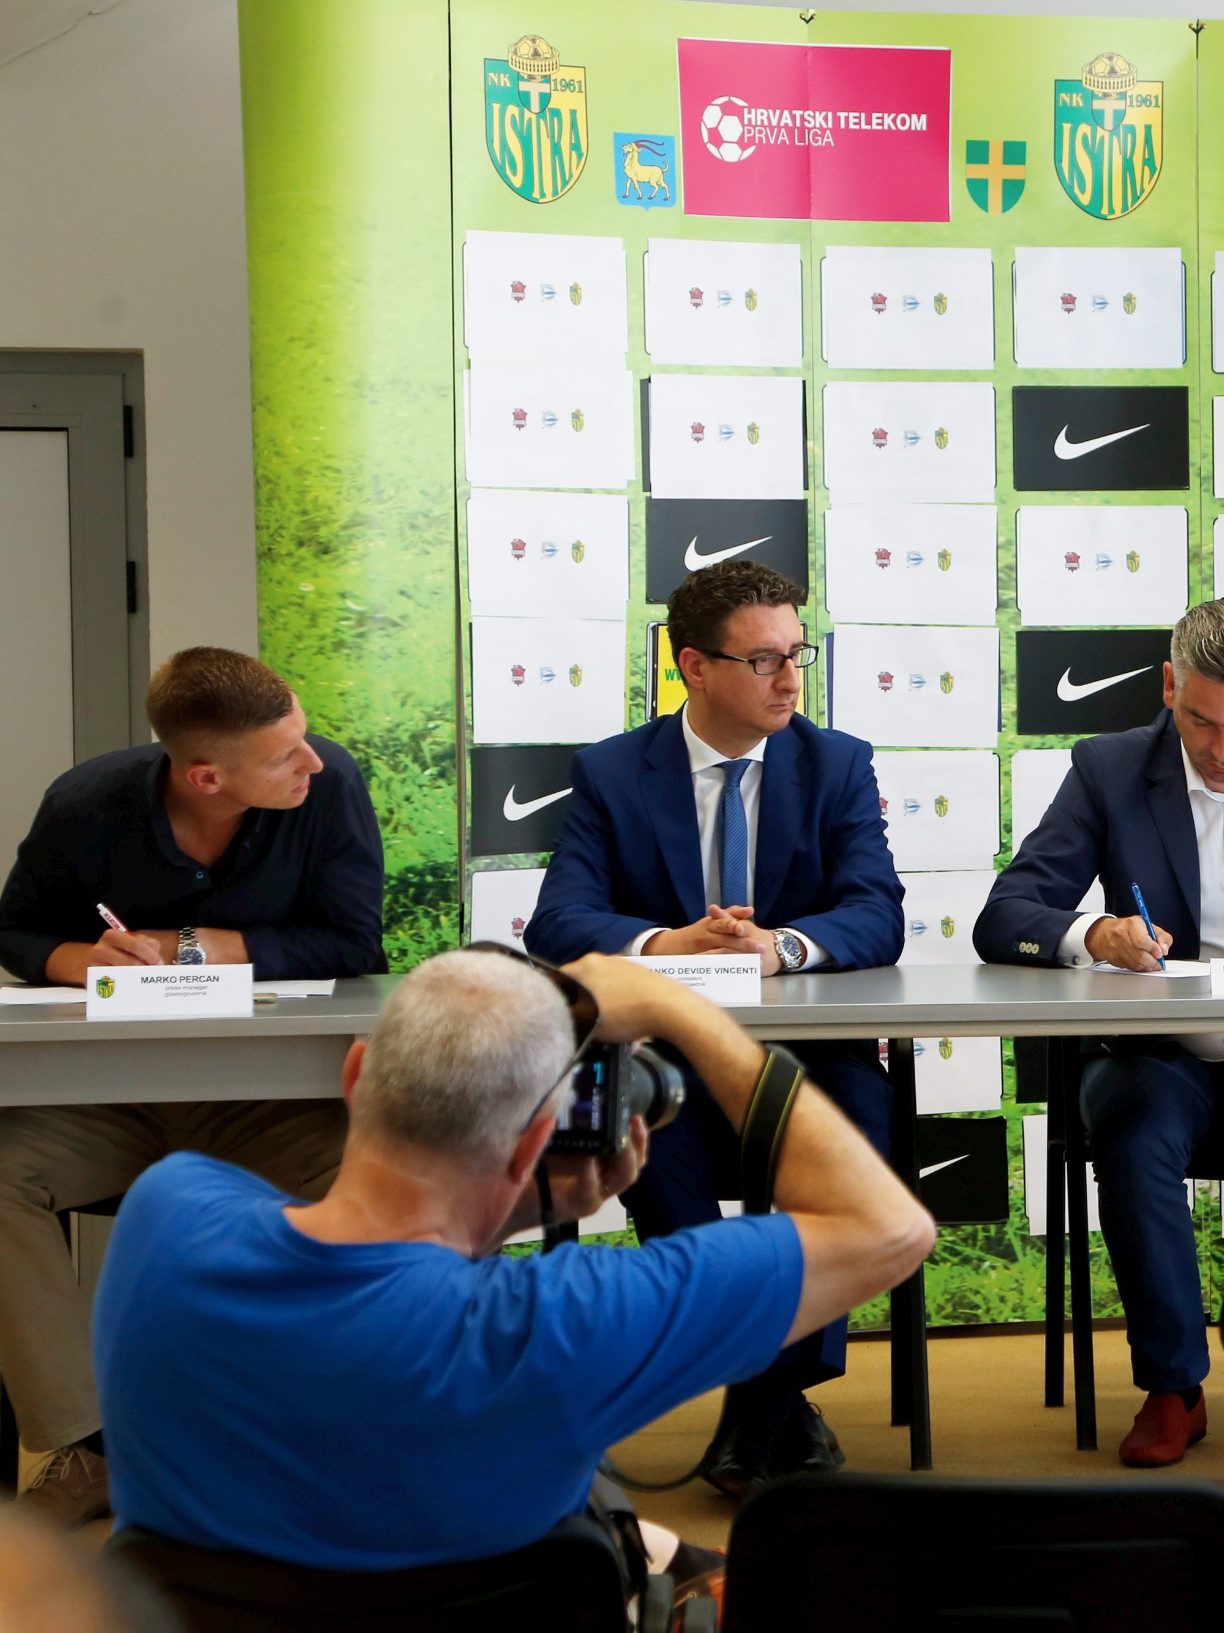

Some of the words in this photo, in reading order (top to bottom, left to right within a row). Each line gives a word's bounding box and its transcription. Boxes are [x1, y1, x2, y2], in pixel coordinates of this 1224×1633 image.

[488, 72, 511, 88] NK
[552, 78, 584, 94] 1961
[1059, 93, 1084, 107] NK
[1127, 94, 1160, 108] 1961
[743, 108, 833, 128] HRVATSKI
[836, 112, 927, 131] TELEKOM
[744, 126, 790, 144] PRVA
[794, 129, 834, 146] LIGA
[491, 102, 584, 199] ISTRA
[1061, 122, 1157, 216] ISTRA
[677, 967, 711, 975] DEVIDE
[140, 976, 177, 984] MARKO
[179, 975, 220, 983] PERCAN
